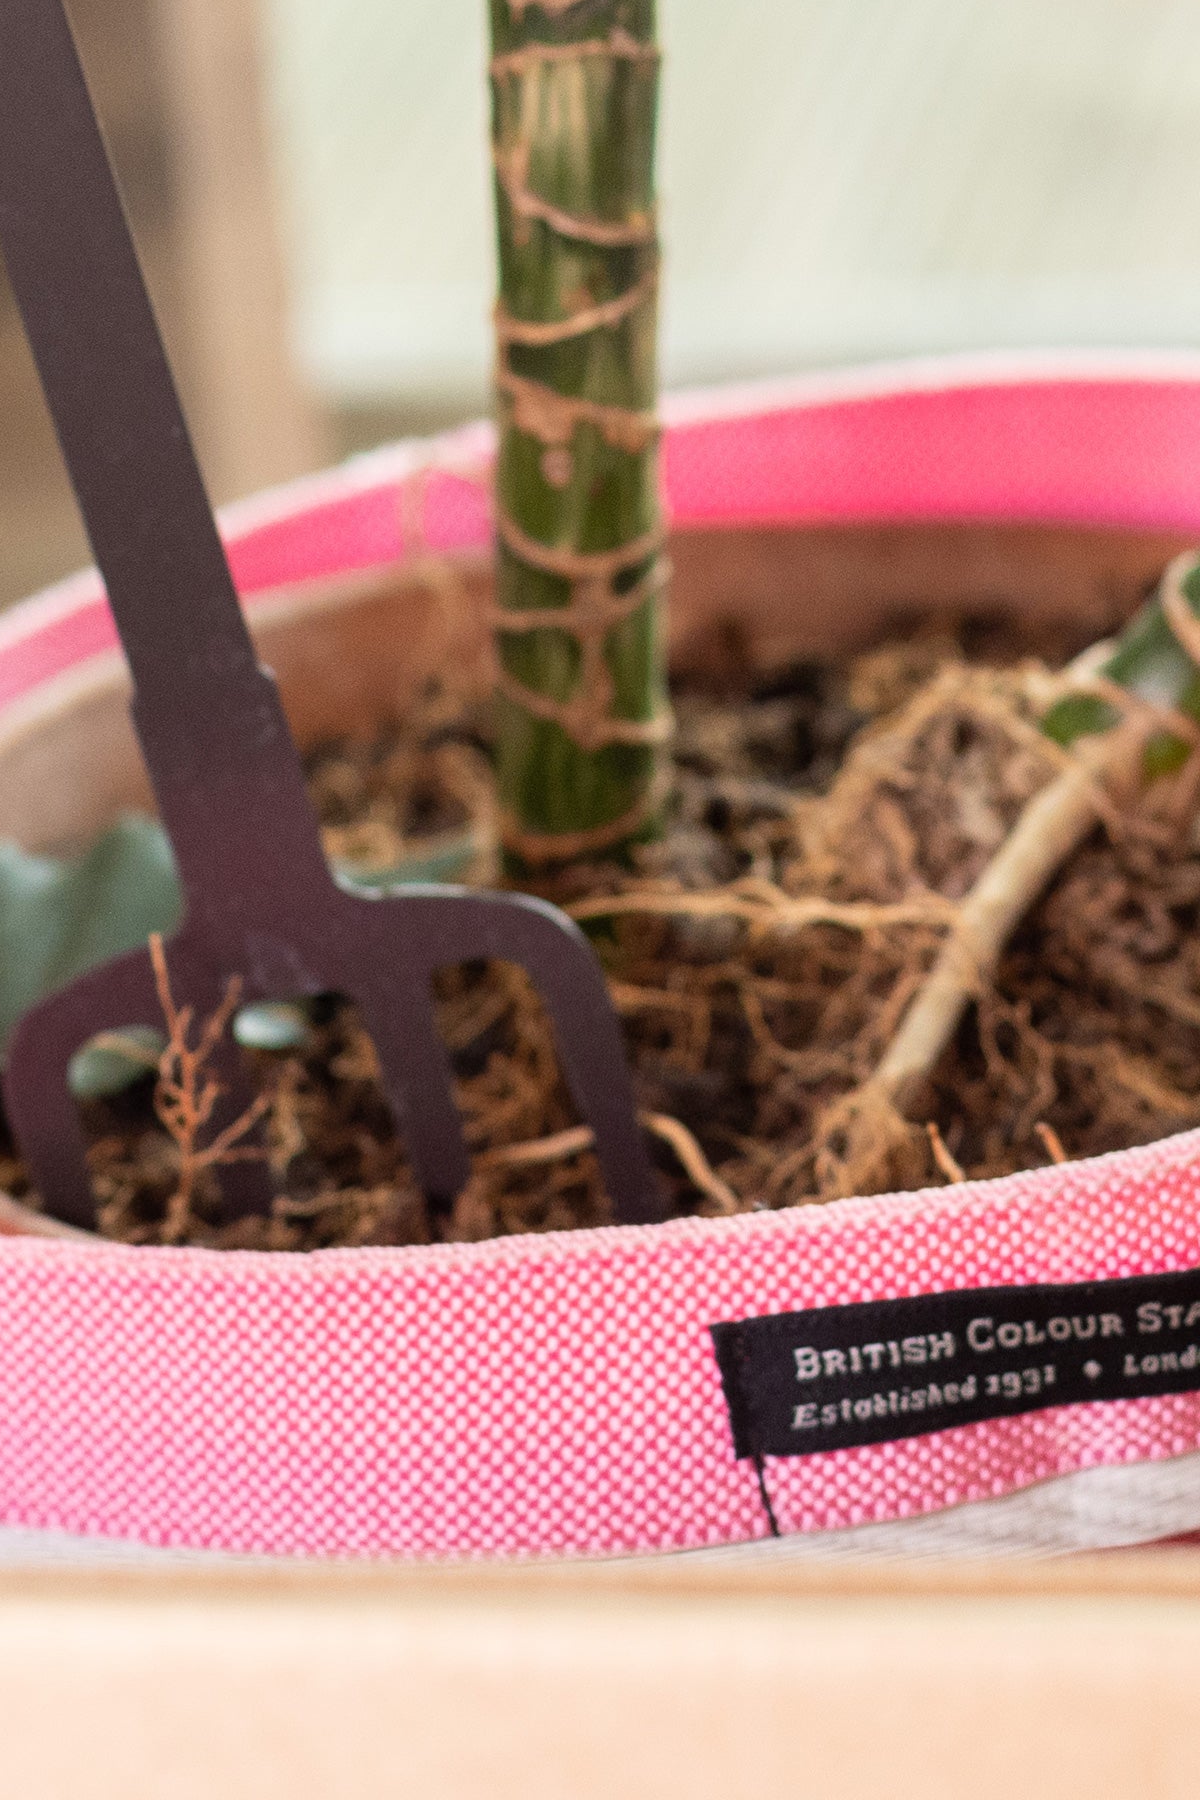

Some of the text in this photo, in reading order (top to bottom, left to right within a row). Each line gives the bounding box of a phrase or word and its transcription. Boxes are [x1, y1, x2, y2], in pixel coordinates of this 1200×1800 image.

[790, 1343, 1200, 1432] Established 1931 Lond
